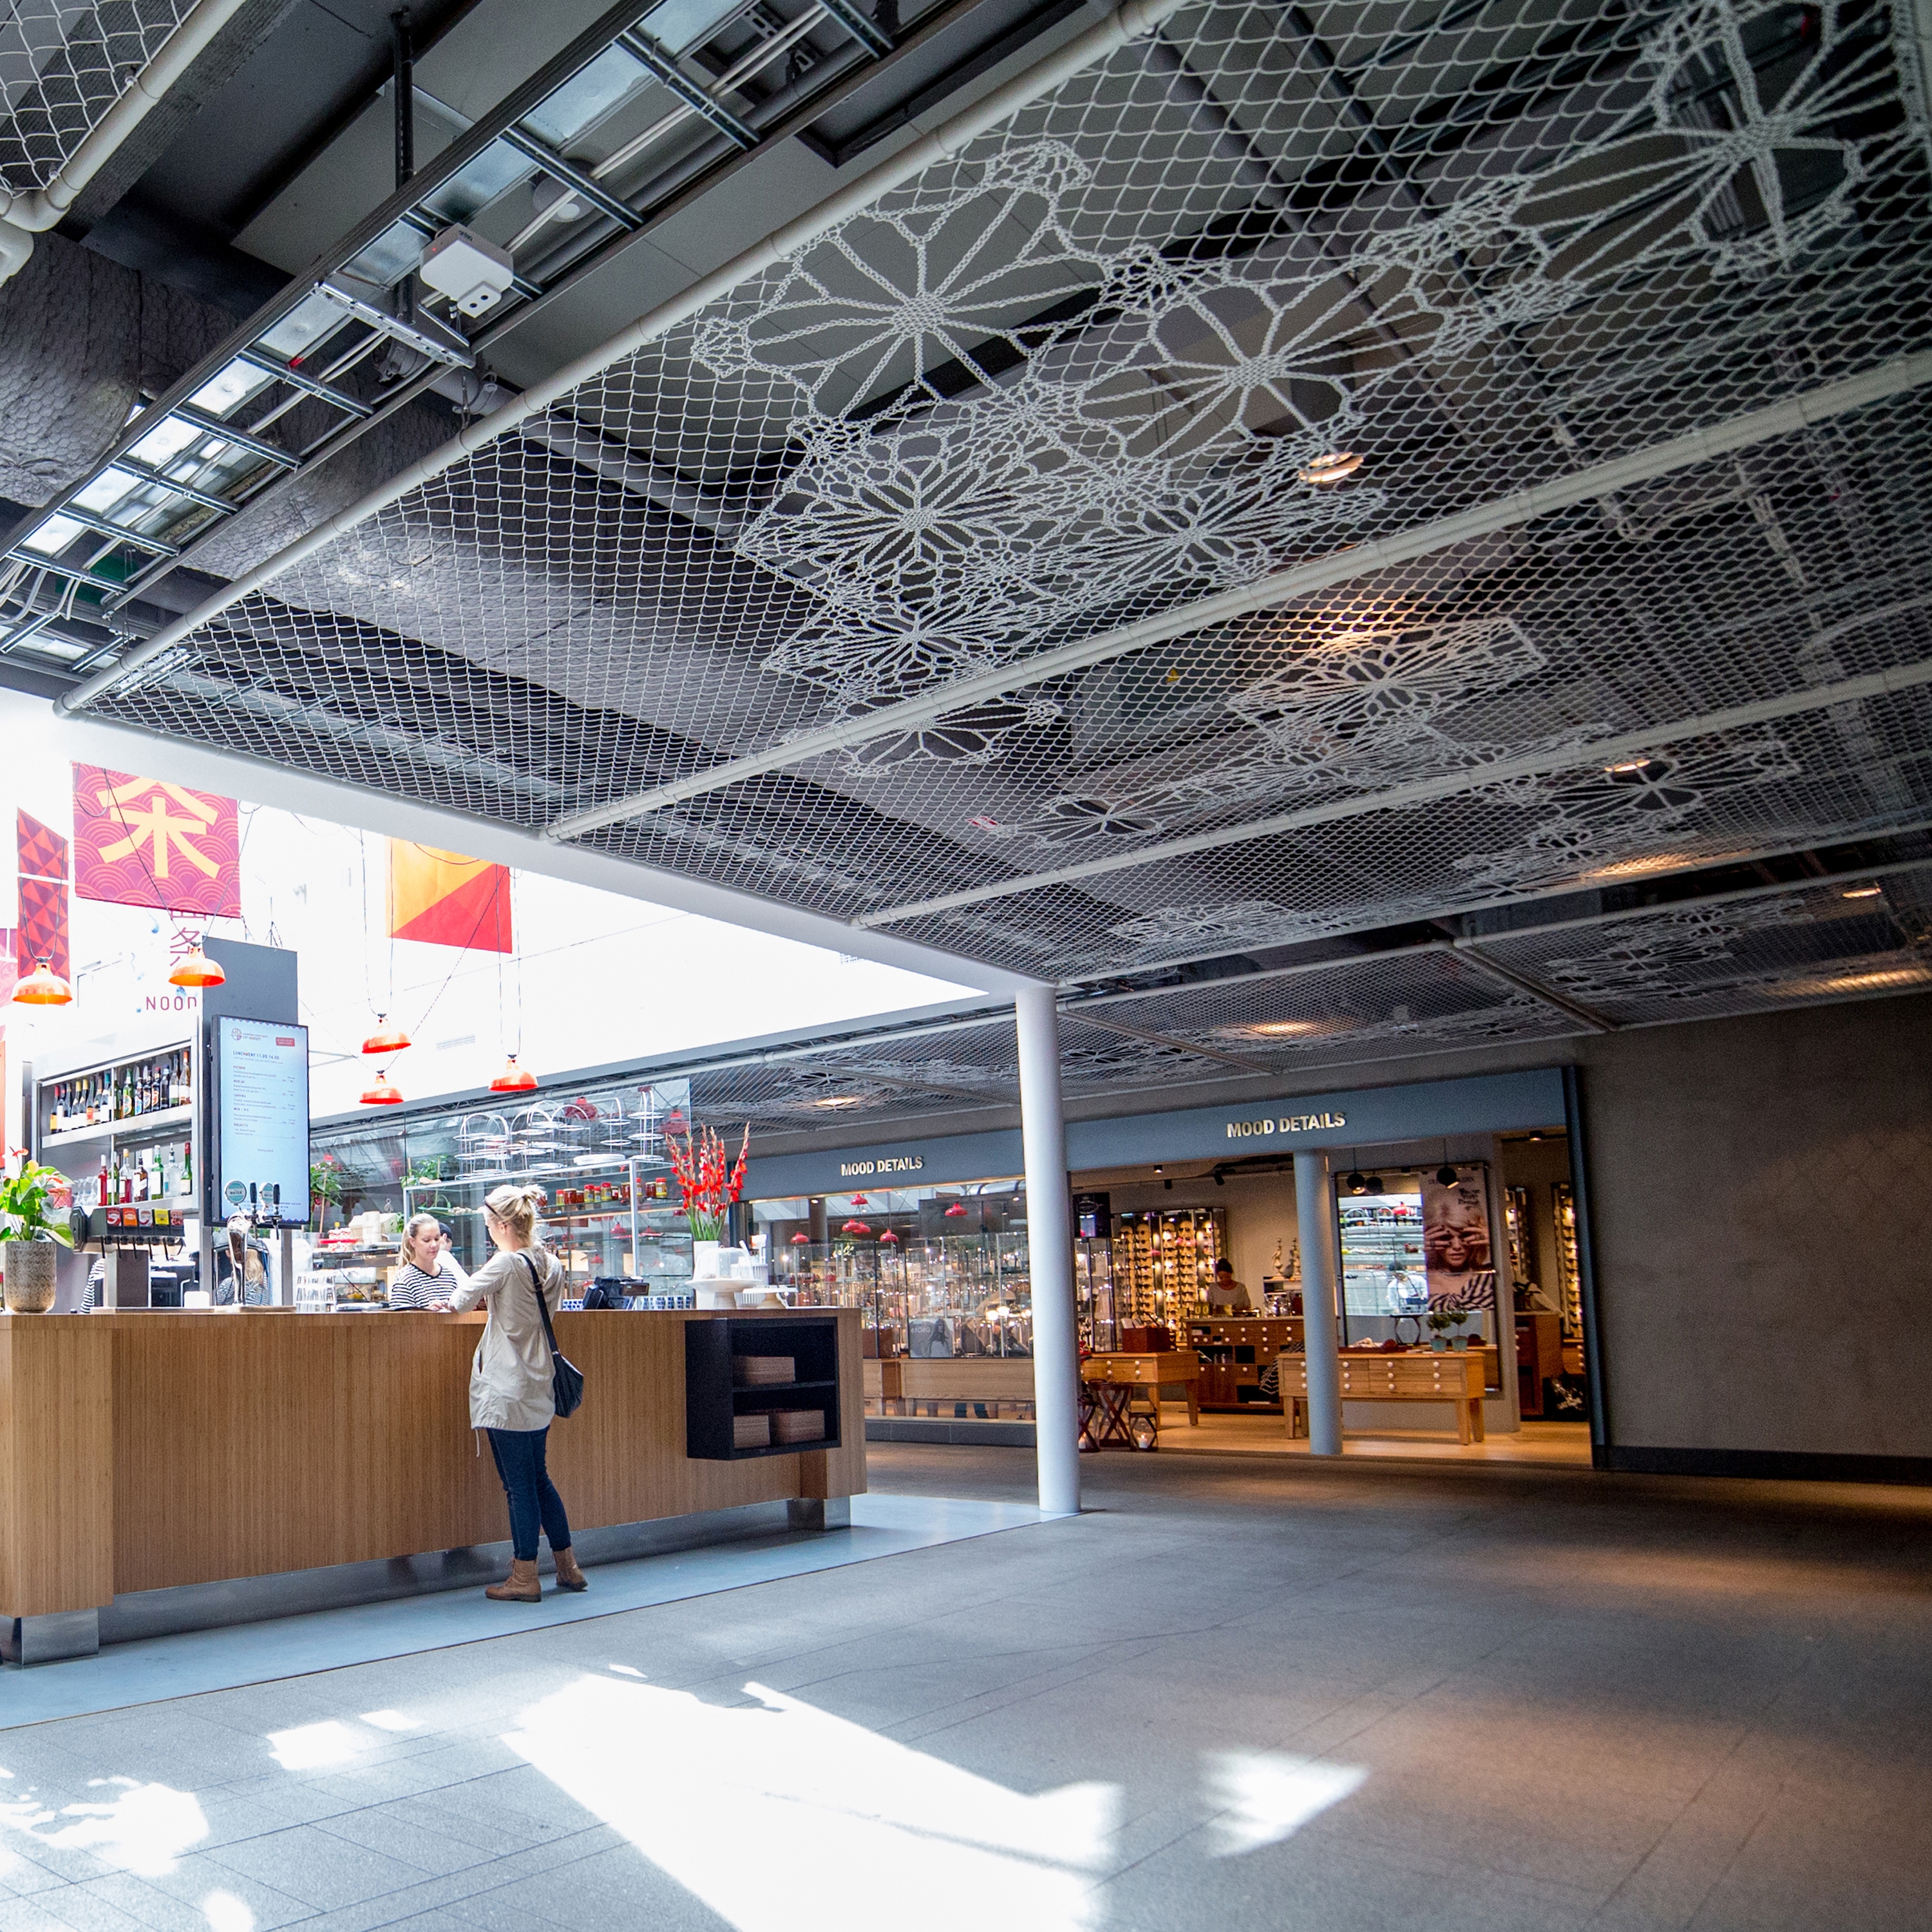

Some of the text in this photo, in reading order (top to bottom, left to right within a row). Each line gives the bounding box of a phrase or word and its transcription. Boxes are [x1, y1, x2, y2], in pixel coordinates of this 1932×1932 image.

[1227, 1112, 1347, 1138] MOOD DETAILS
[840, 1156, 923, 1177] MOOD DETAILS
